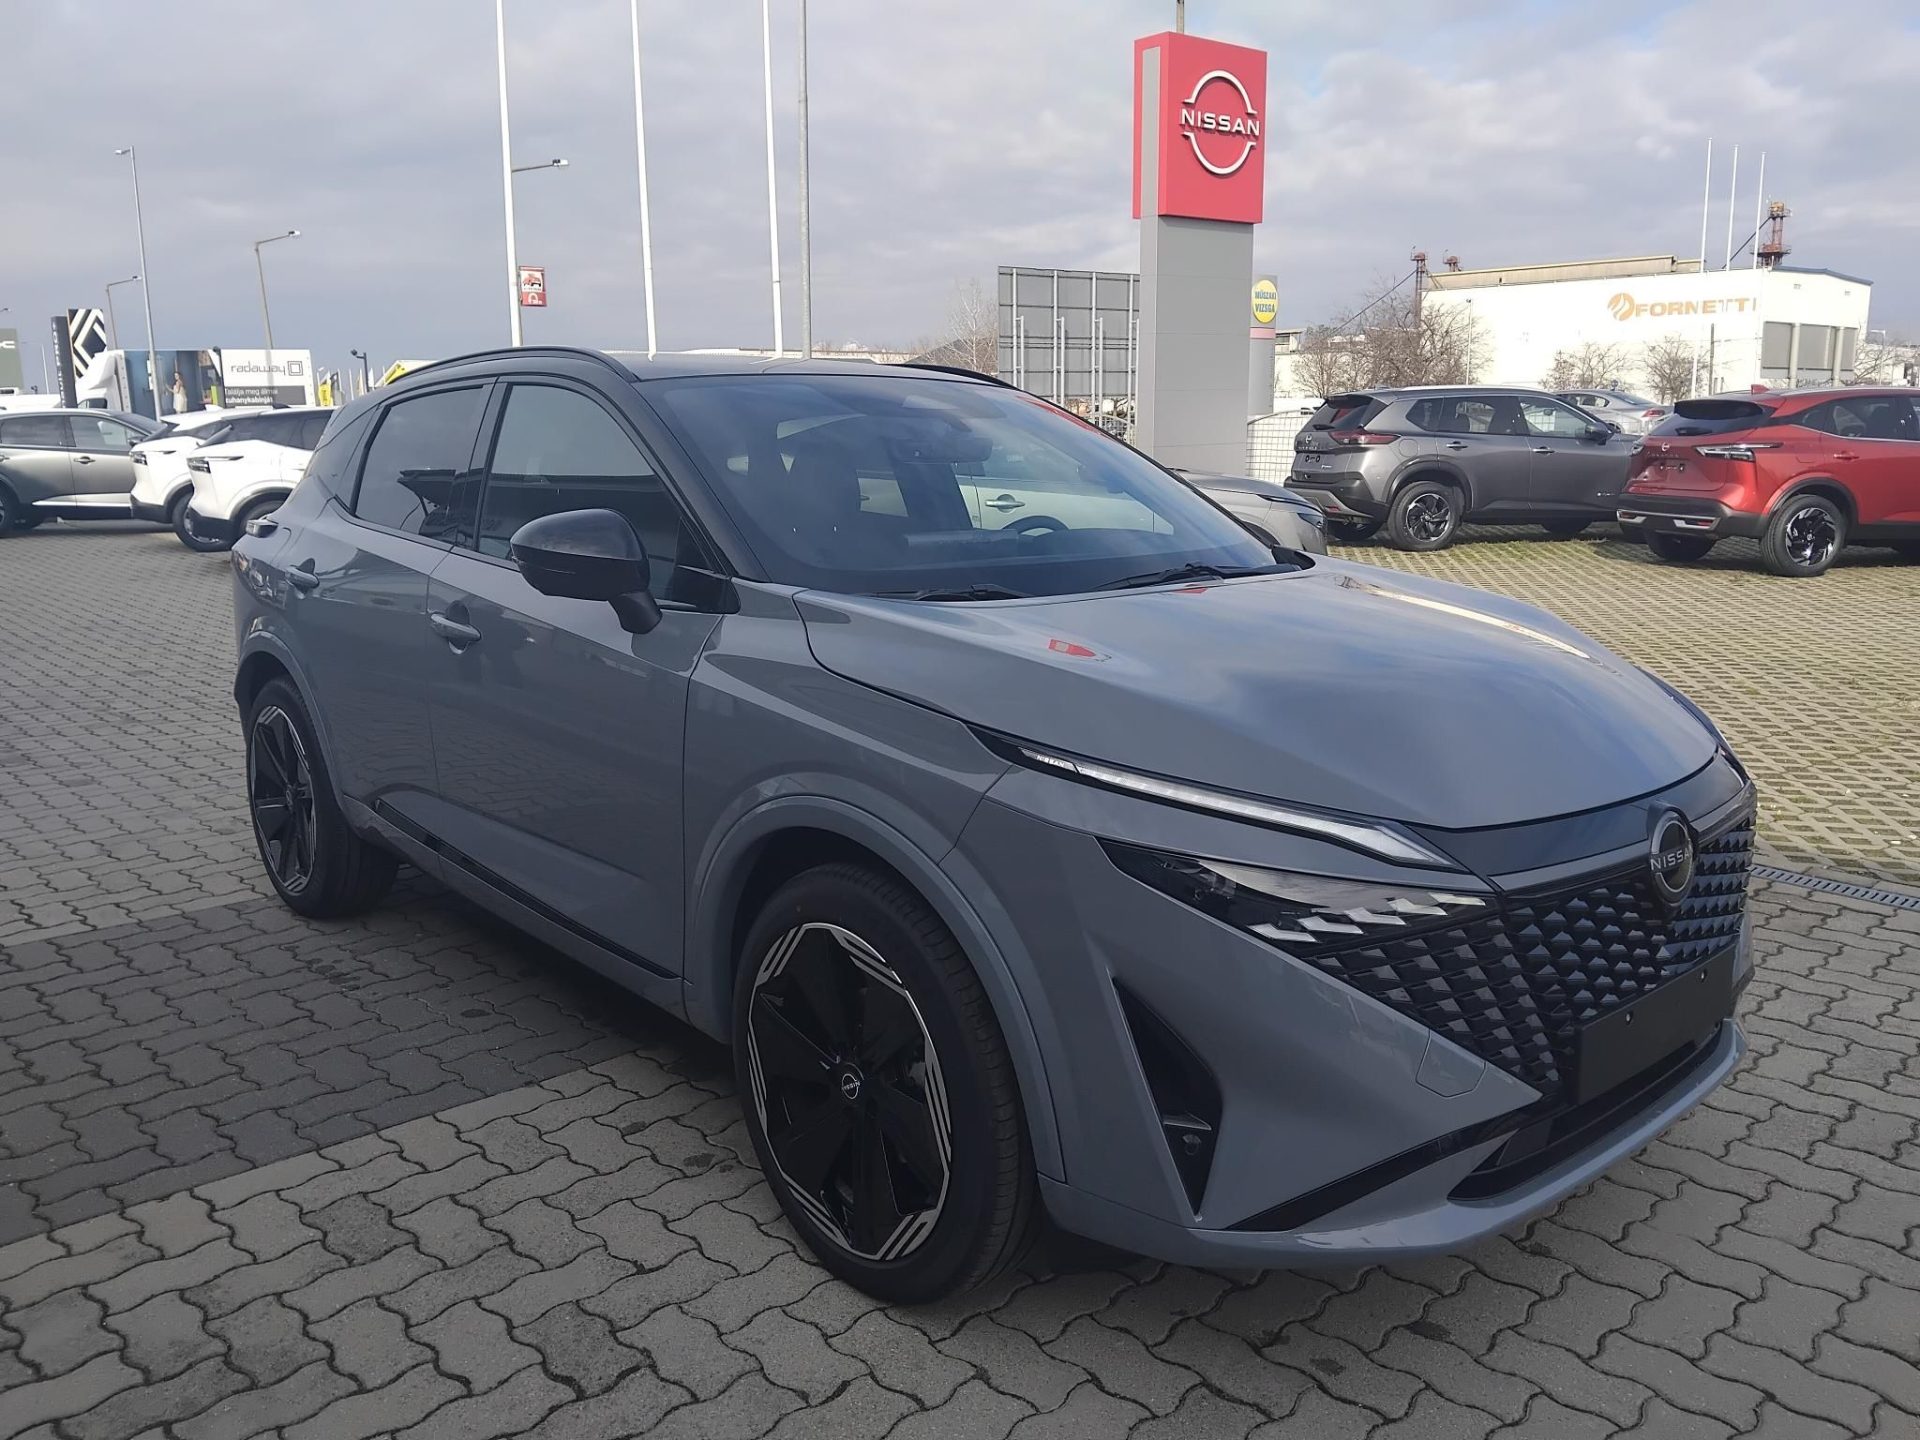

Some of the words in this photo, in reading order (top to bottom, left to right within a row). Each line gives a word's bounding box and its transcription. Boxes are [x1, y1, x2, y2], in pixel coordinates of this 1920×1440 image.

[1181, 108, 1260, 136] NISSAN
[1254, 303, 1276, 313] VIZSGA
[1635, 297, 1757, 317] FORNETTI
[231, 360, 286, 376] radaway
